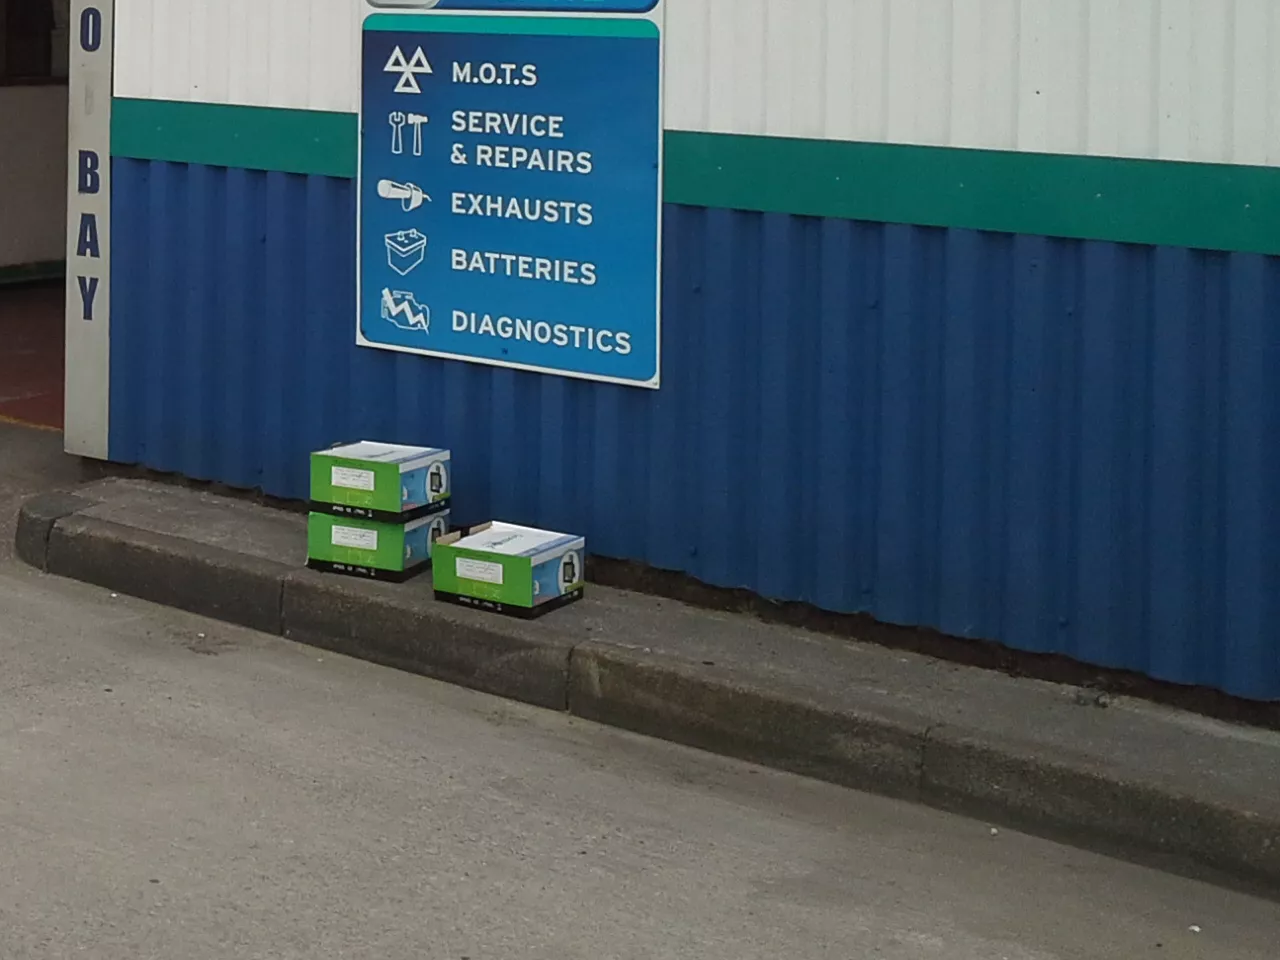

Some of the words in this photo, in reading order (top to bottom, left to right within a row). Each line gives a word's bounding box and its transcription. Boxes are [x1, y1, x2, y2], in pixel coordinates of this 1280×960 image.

[452, 61, 537, 86] M.O.T.S
[451, 110, 564, 138] SERVICE
[451, 143, 468, 165] &
[476, 145, 592, 174] REPAIRS
[451, 192, 593, 226] EXHAUSTS
[77, 150, 100, 321] BAY
[451, 248, 597, 286] BATTERIES
[452, 310, 632, 355] DIAGNOSTICS
